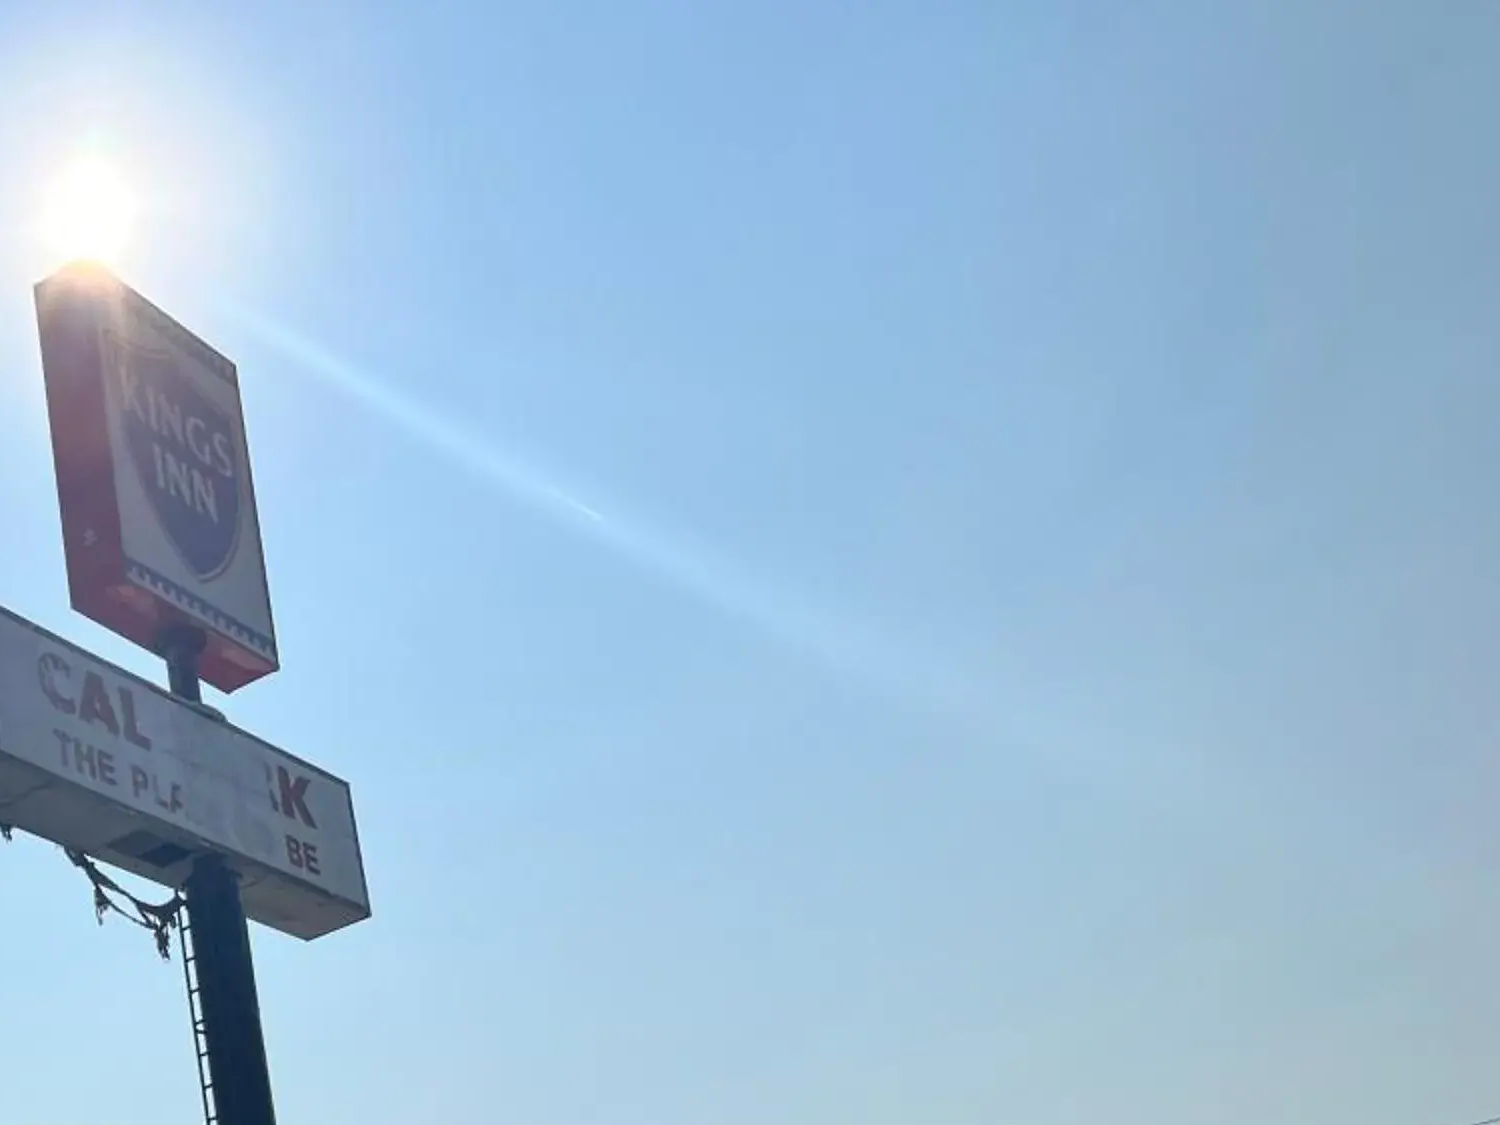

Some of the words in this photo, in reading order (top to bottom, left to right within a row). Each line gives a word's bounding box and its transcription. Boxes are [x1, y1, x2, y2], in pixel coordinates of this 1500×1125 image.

[118, 365, 233, 477] KINGS
[152, 441, 219, 525] INN
[37, 651, 153, 752] CAL
[264, 761, 318, 830] K
[52, 728, 117, 786] THE
[284, 834, 321, 876] BE
